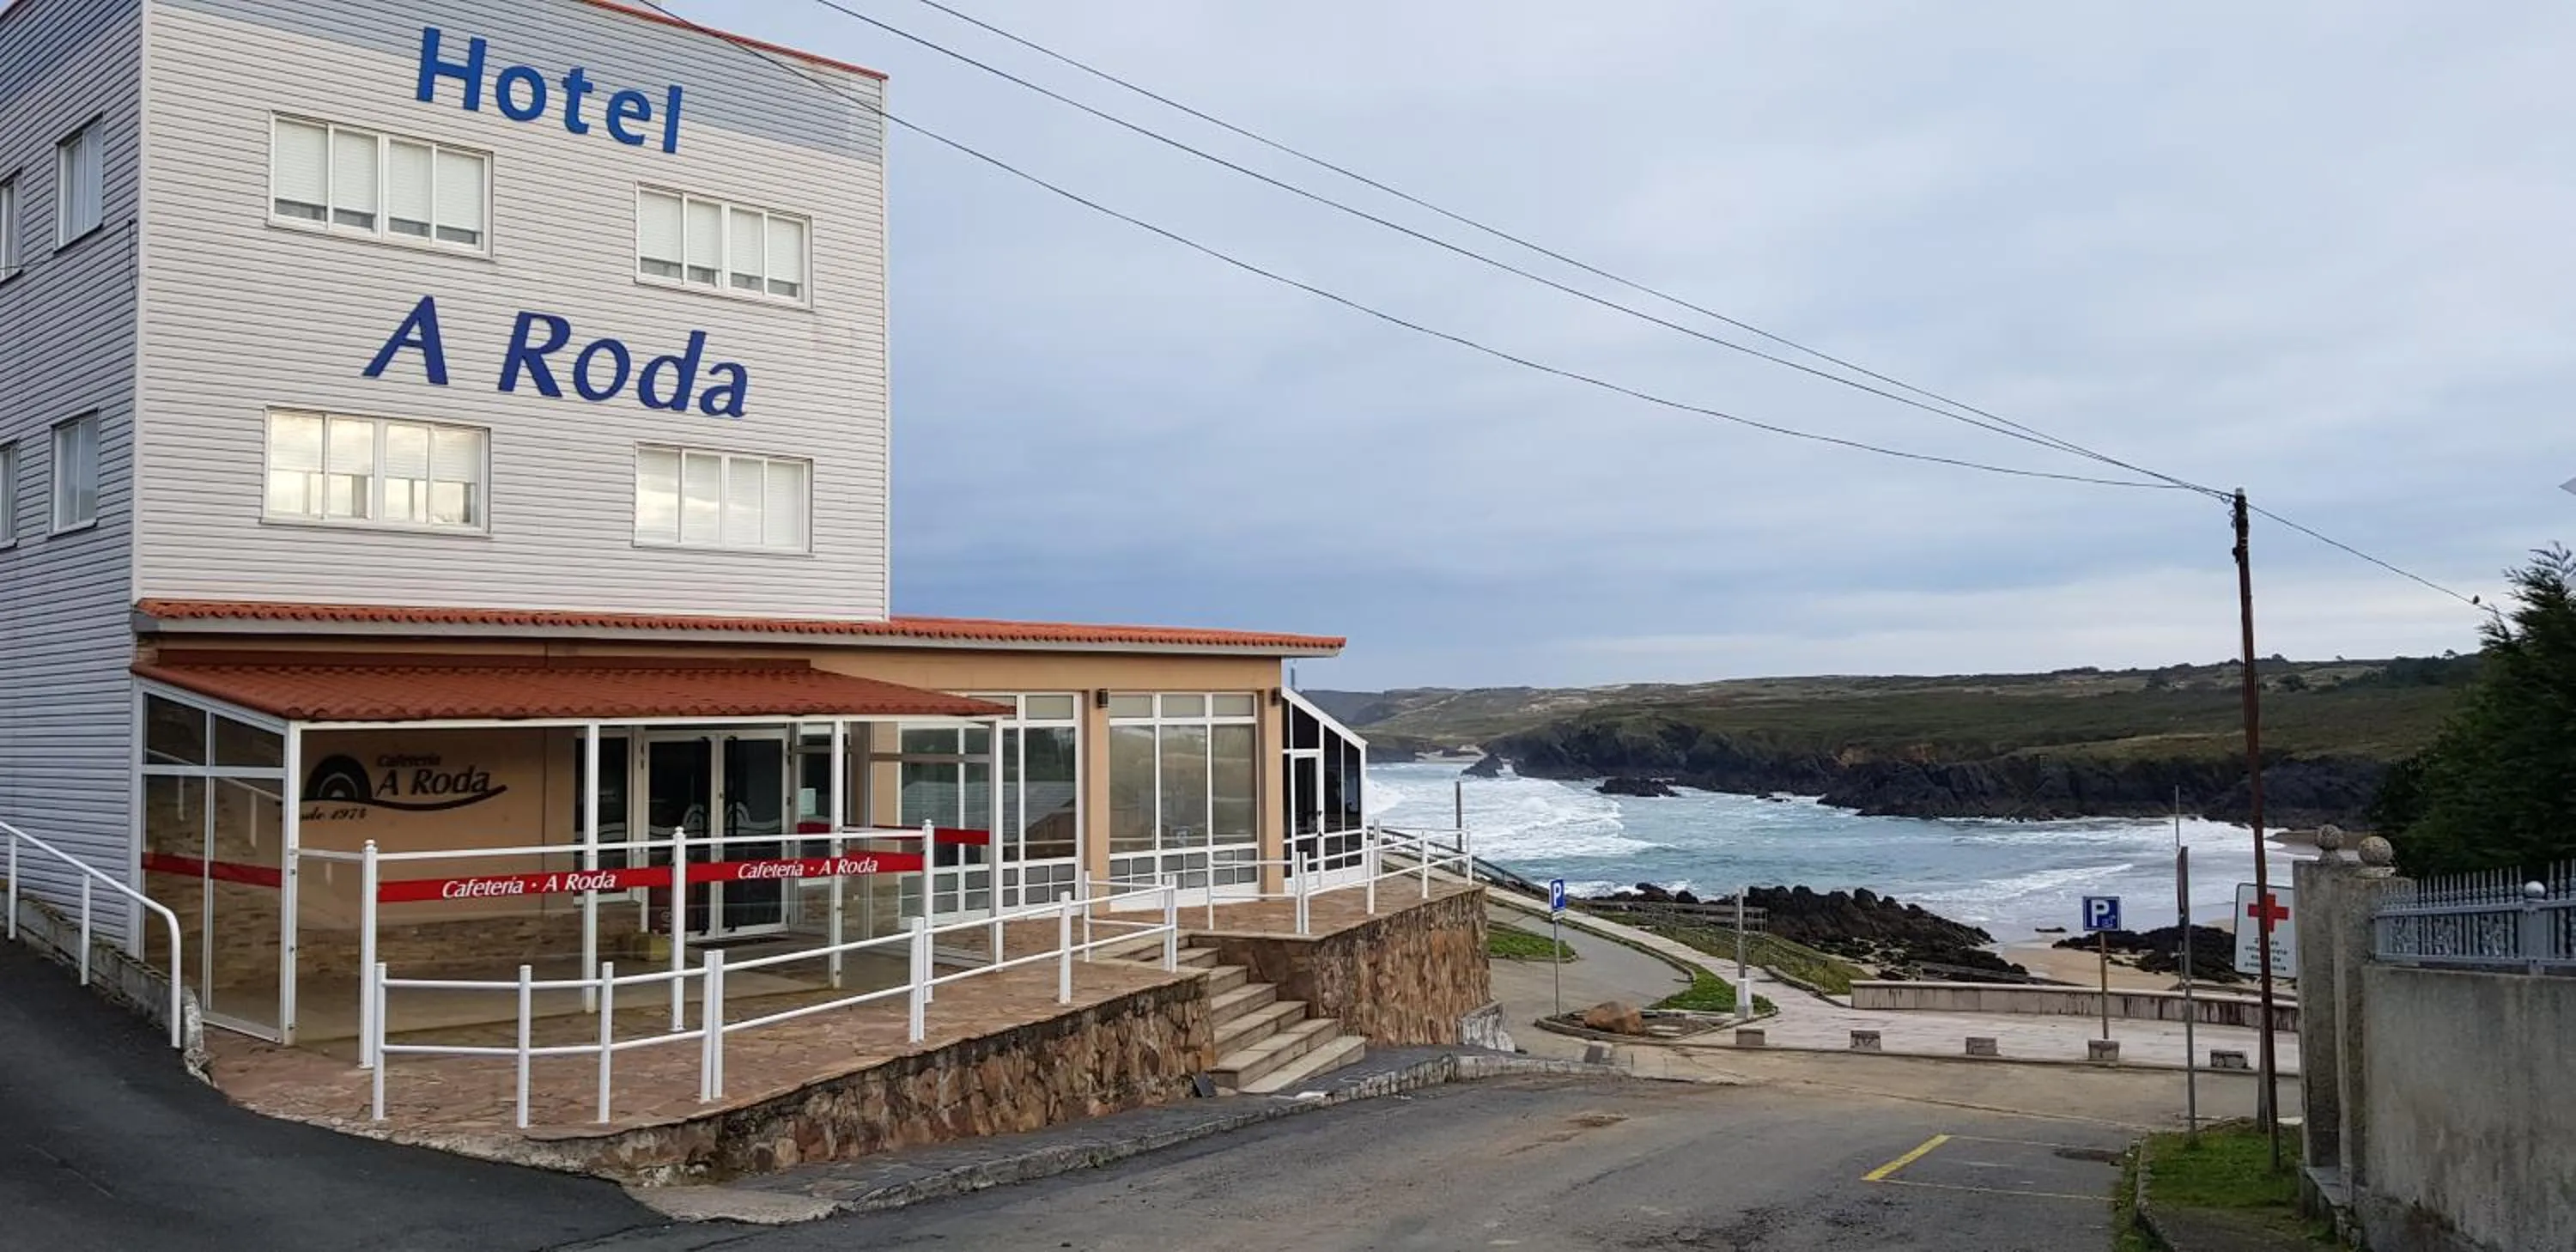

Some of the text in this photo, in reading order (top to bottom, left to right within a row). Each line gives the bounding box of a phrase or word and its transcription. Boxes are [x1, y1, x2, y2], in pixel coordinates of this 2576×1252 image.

[416, 27, 683, 155] Hotel
[361, 295, 749, 419] A Roda
[374, 764, 490, 797] A Roda
[817, 860, 831, 875] A
[835, 856, 879, 874] Roda
[542, 874, 557, 892] A
[564, 870, 617, 890] Roda
[1553, 882, 1562, 907] P
[2091, 899, 2110, 927] P
